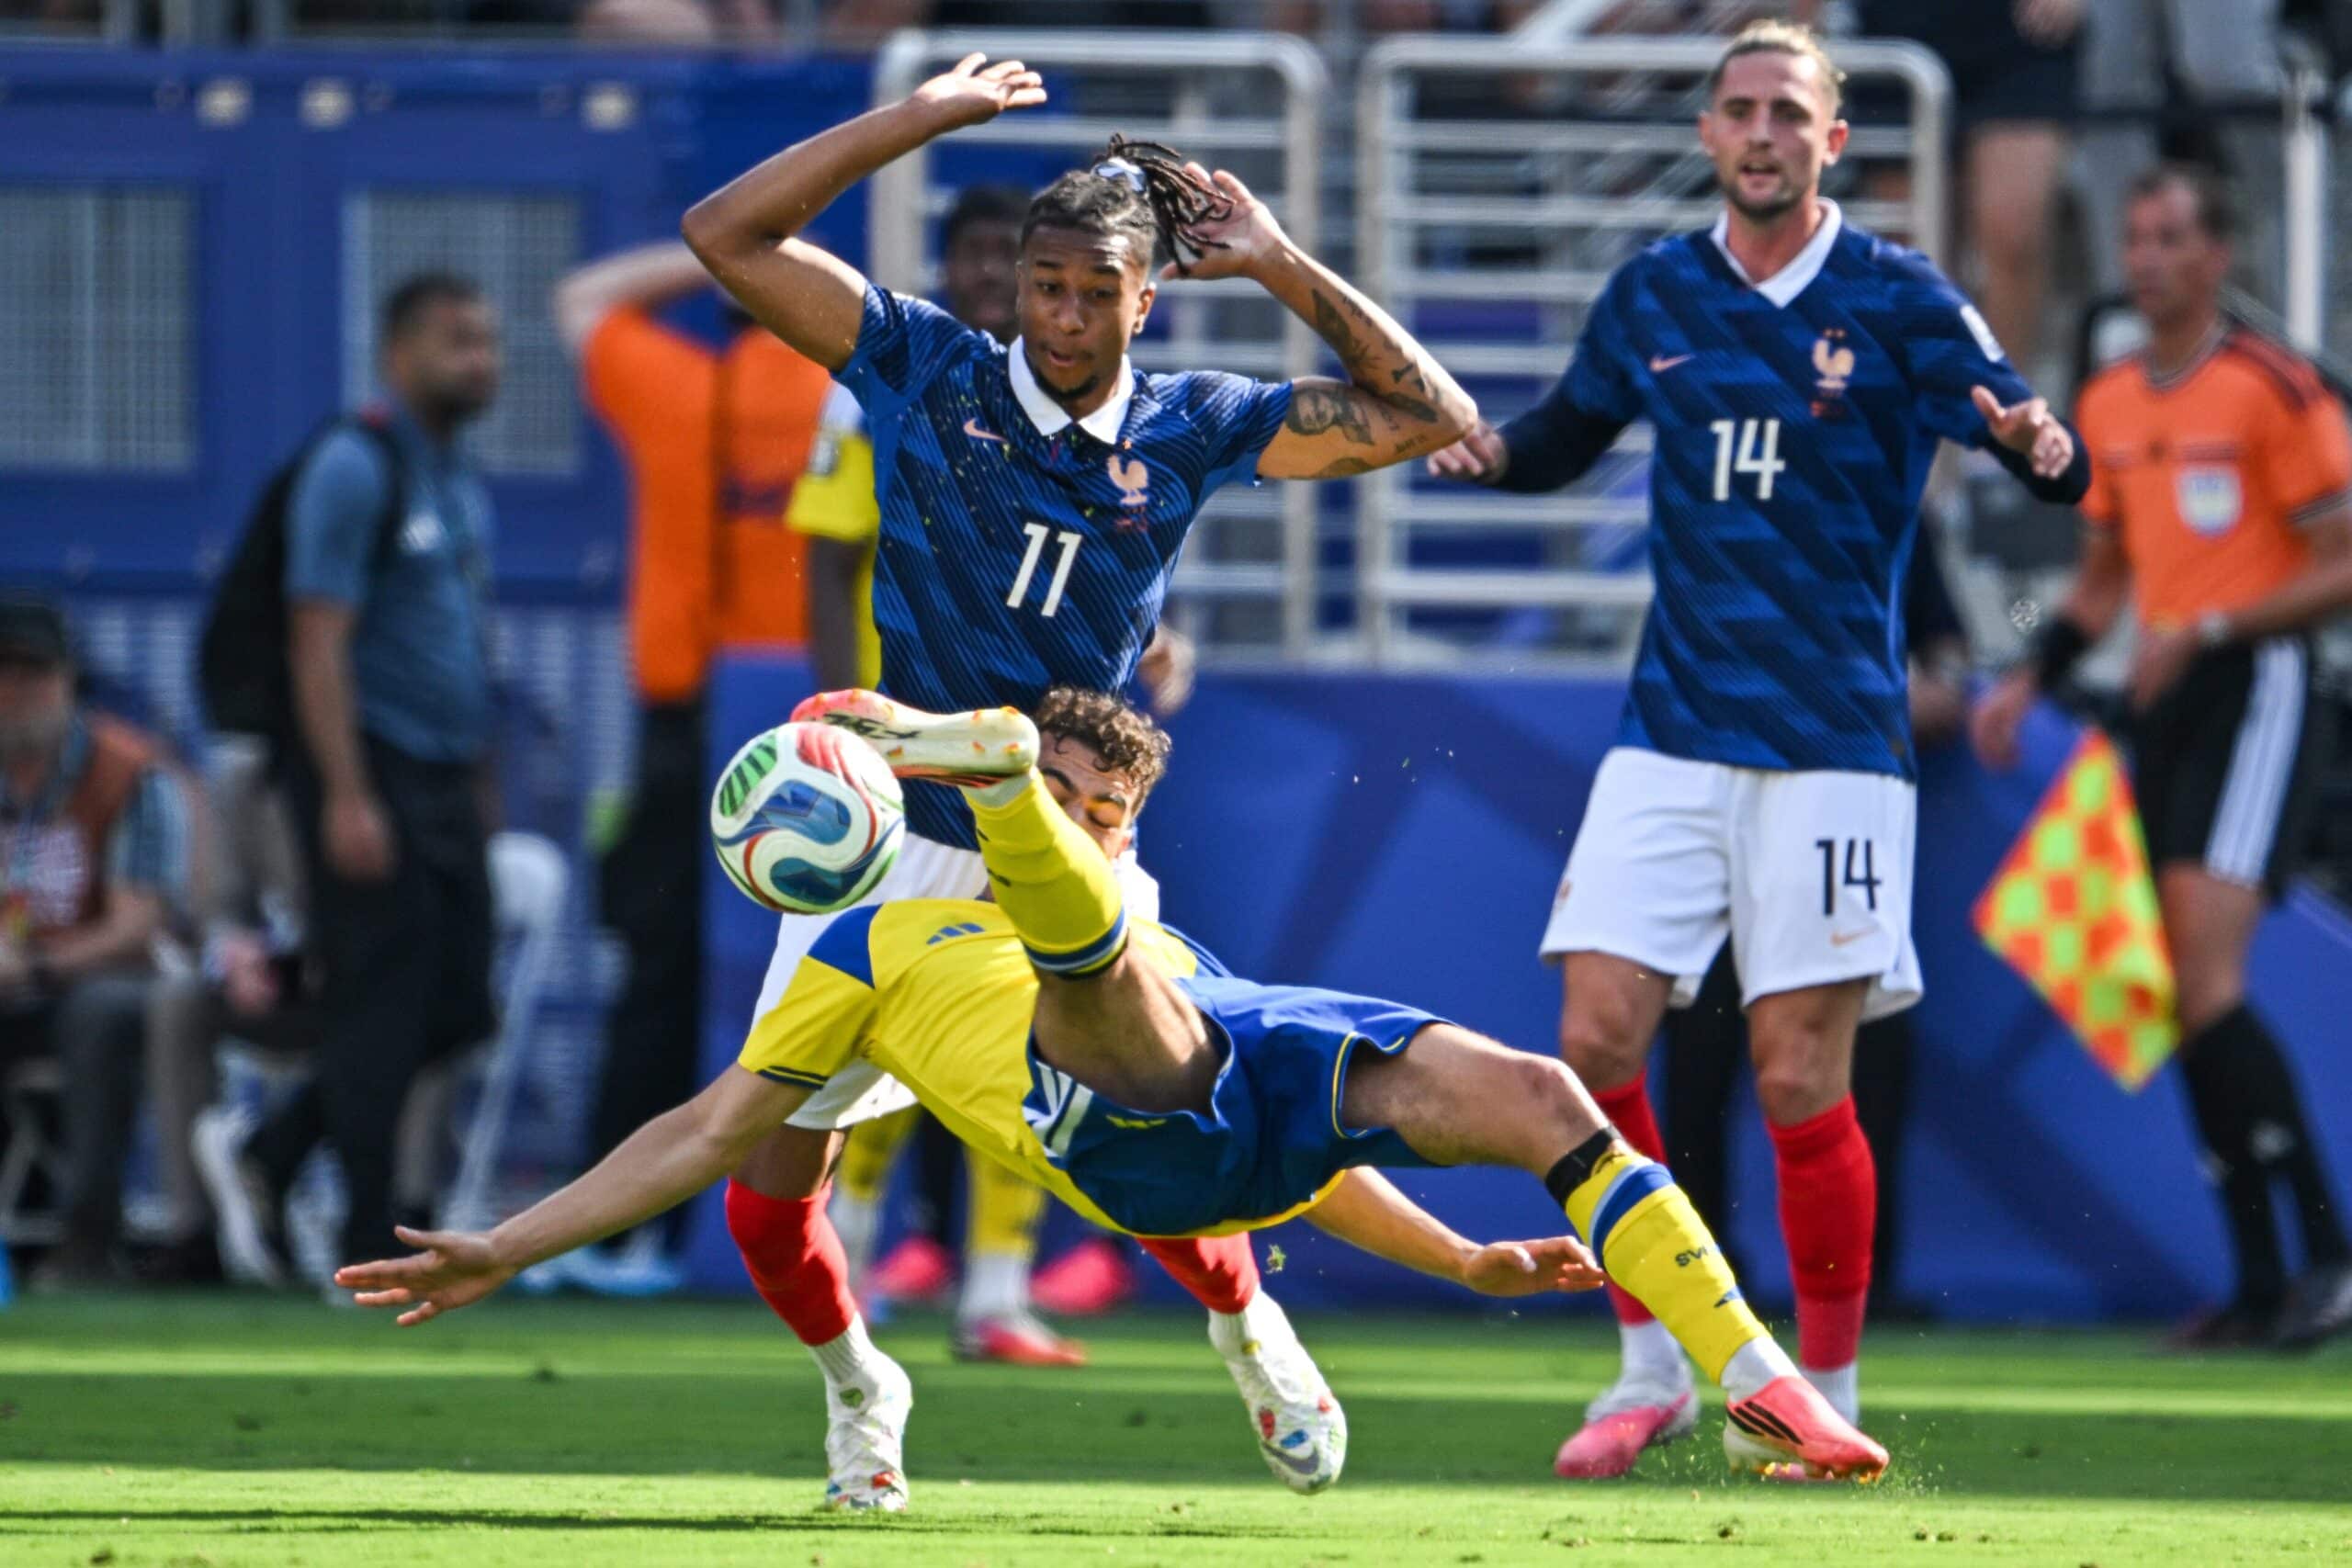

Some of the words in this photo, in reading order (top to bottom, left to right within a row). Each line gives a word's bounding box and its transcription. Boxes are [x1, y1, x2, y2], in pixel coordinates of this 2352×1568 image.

[1710, 419, 1786, 502] 14
[1006, 522, 1083, 617] 11
[1815, 838, 1883, 917] 14
